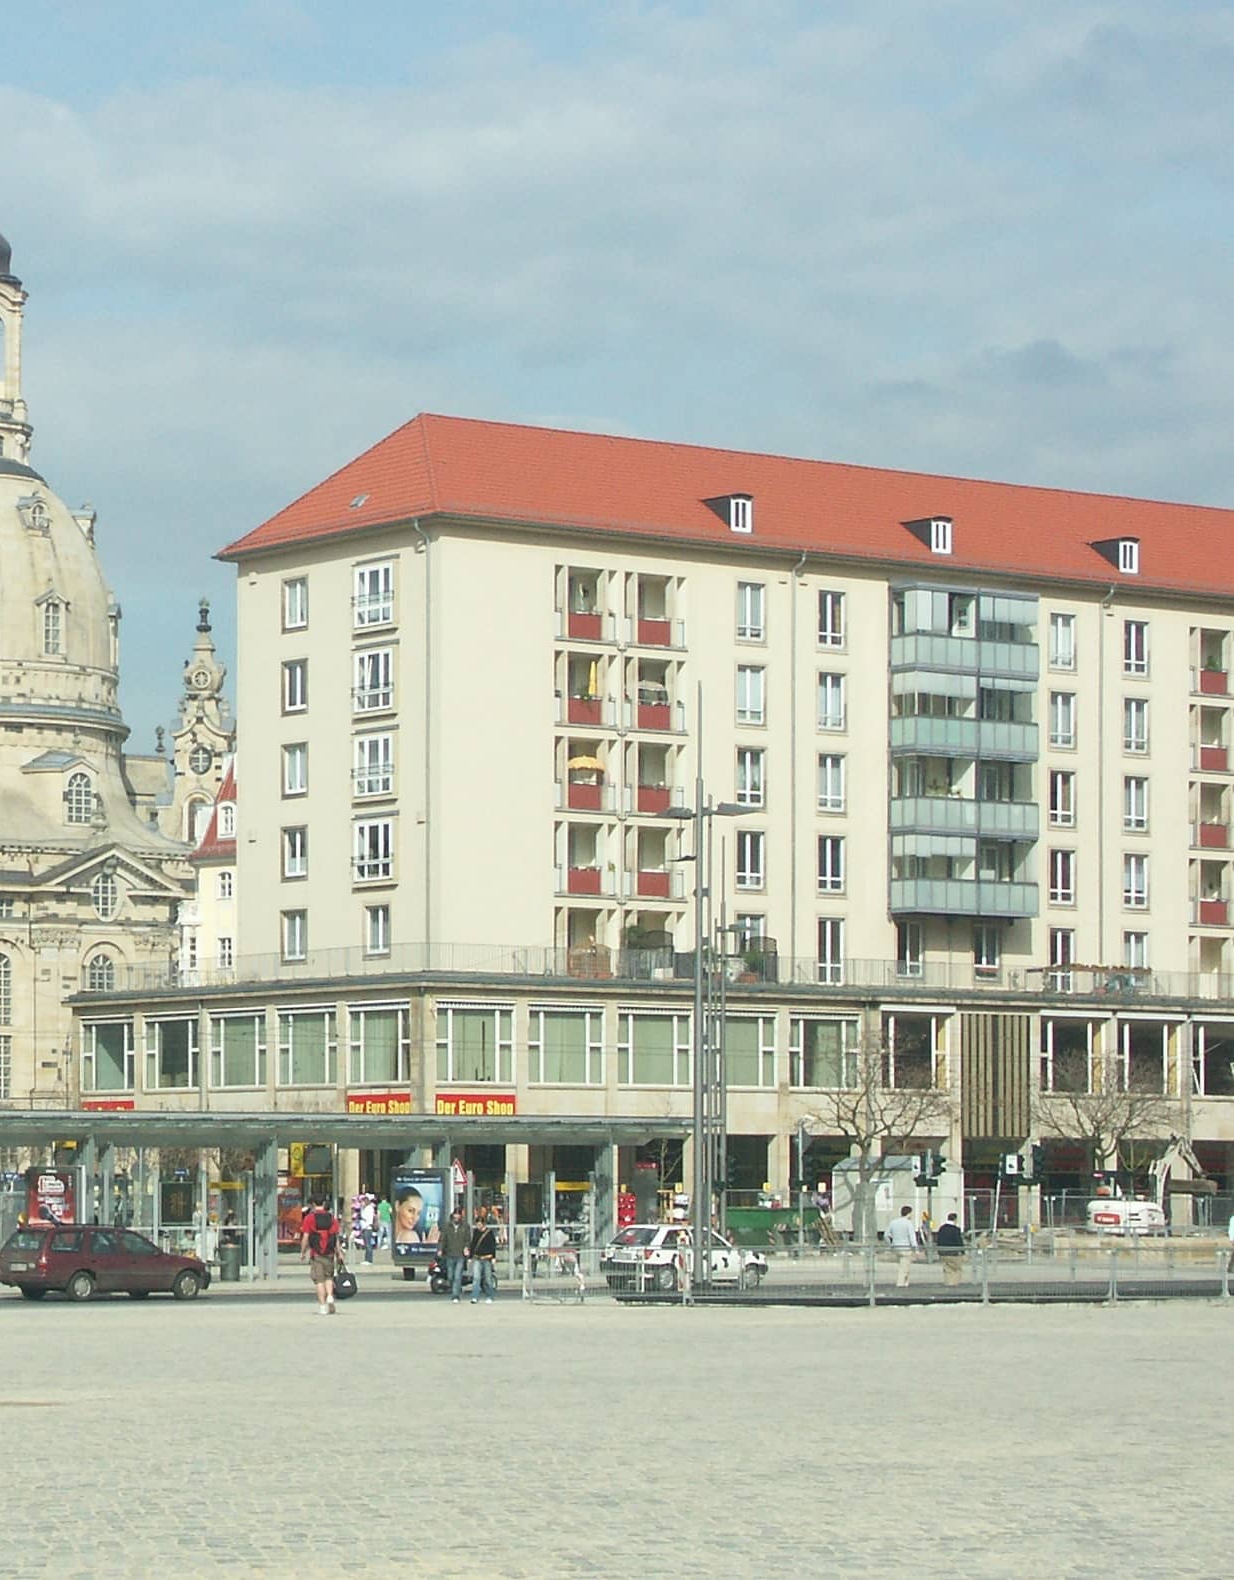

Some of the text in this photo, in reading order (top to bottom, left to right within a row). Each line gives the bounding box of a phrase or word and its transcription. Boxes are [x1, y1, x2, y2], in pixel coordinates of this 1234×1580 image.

[348, 1101, 364, 1114] Der
[366, 1100, 386, 1114] Euro
[437, 1099, 457, 1115] Der
[459, 1099, 483, 1115] Euro
